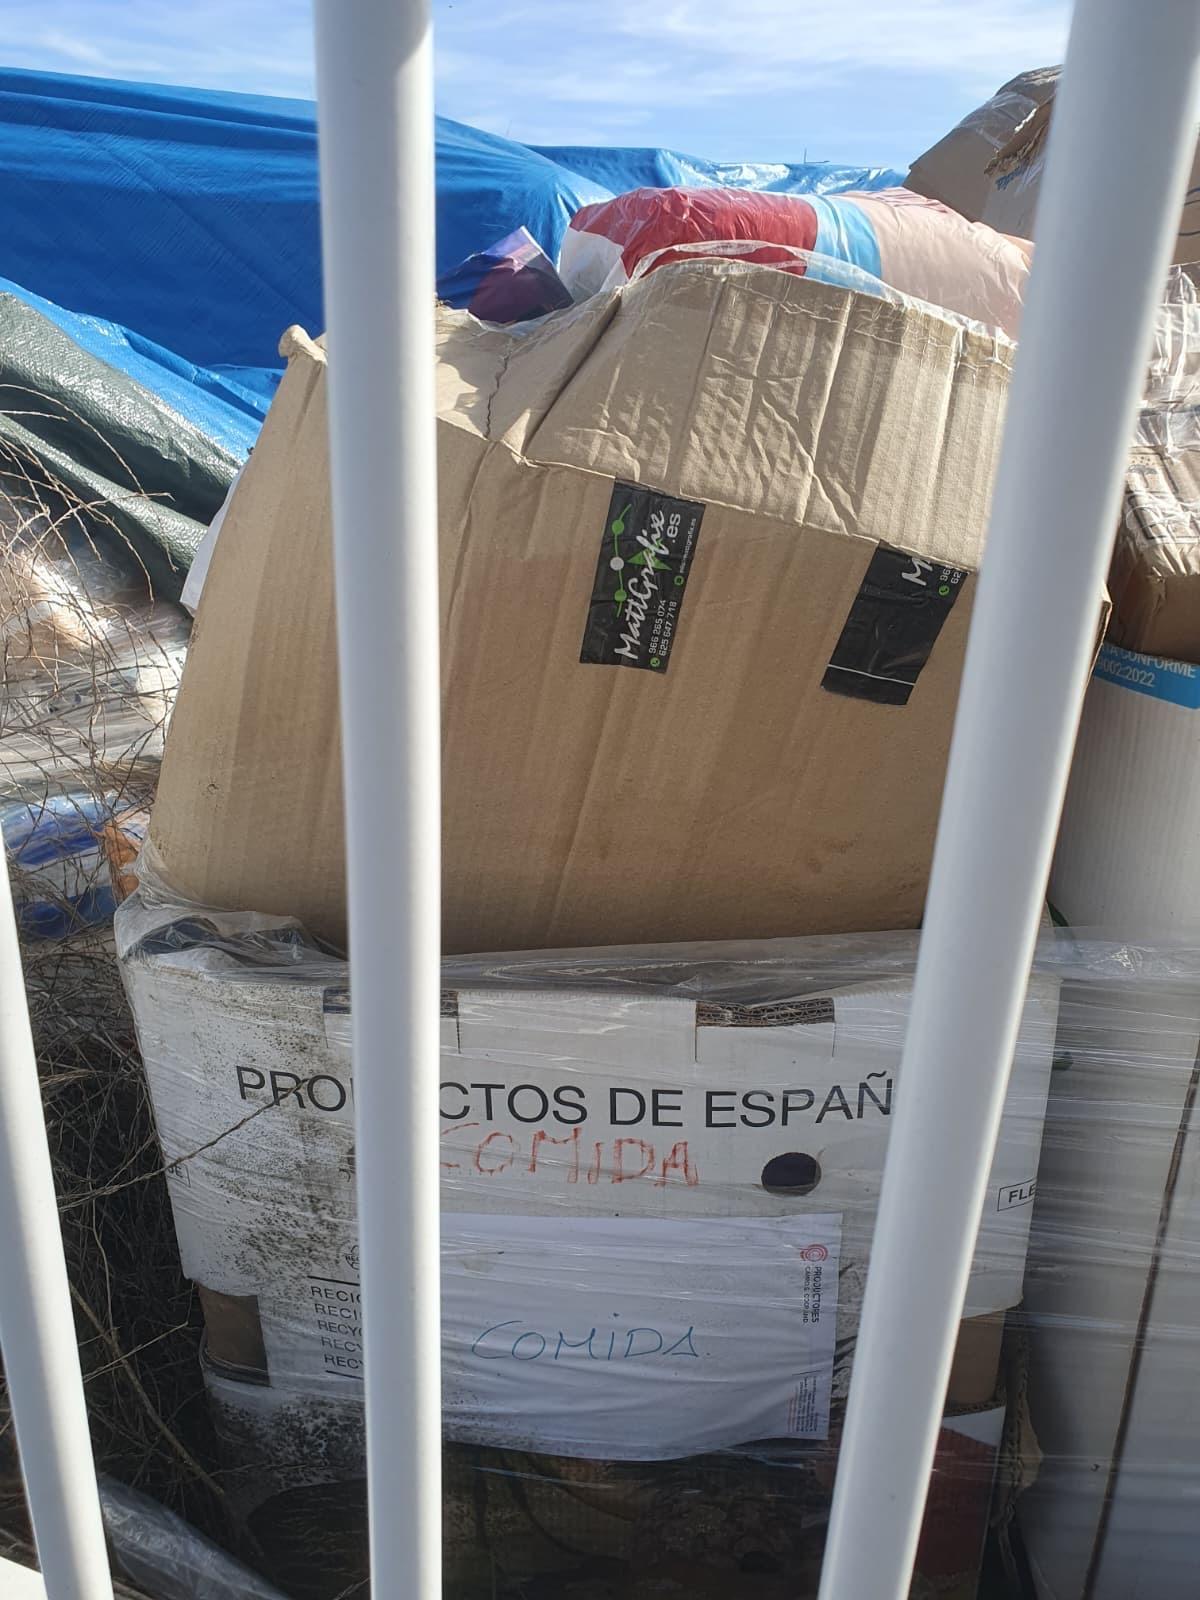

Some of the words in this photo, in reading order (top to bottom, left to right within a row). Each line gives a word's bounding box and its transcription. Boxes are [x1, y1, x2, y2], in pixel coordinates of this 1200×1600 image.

[668, 601, 678, 618] 718
[648, 629, 660, 654] 966
[657, 599, 667, 622] 074
[663, 619, 673, 638] 647
[658, 638, 669, 656] 625
[236, 1065, 589, 1125] PROCTOS
[608, 1087, 683, 1127] DE
